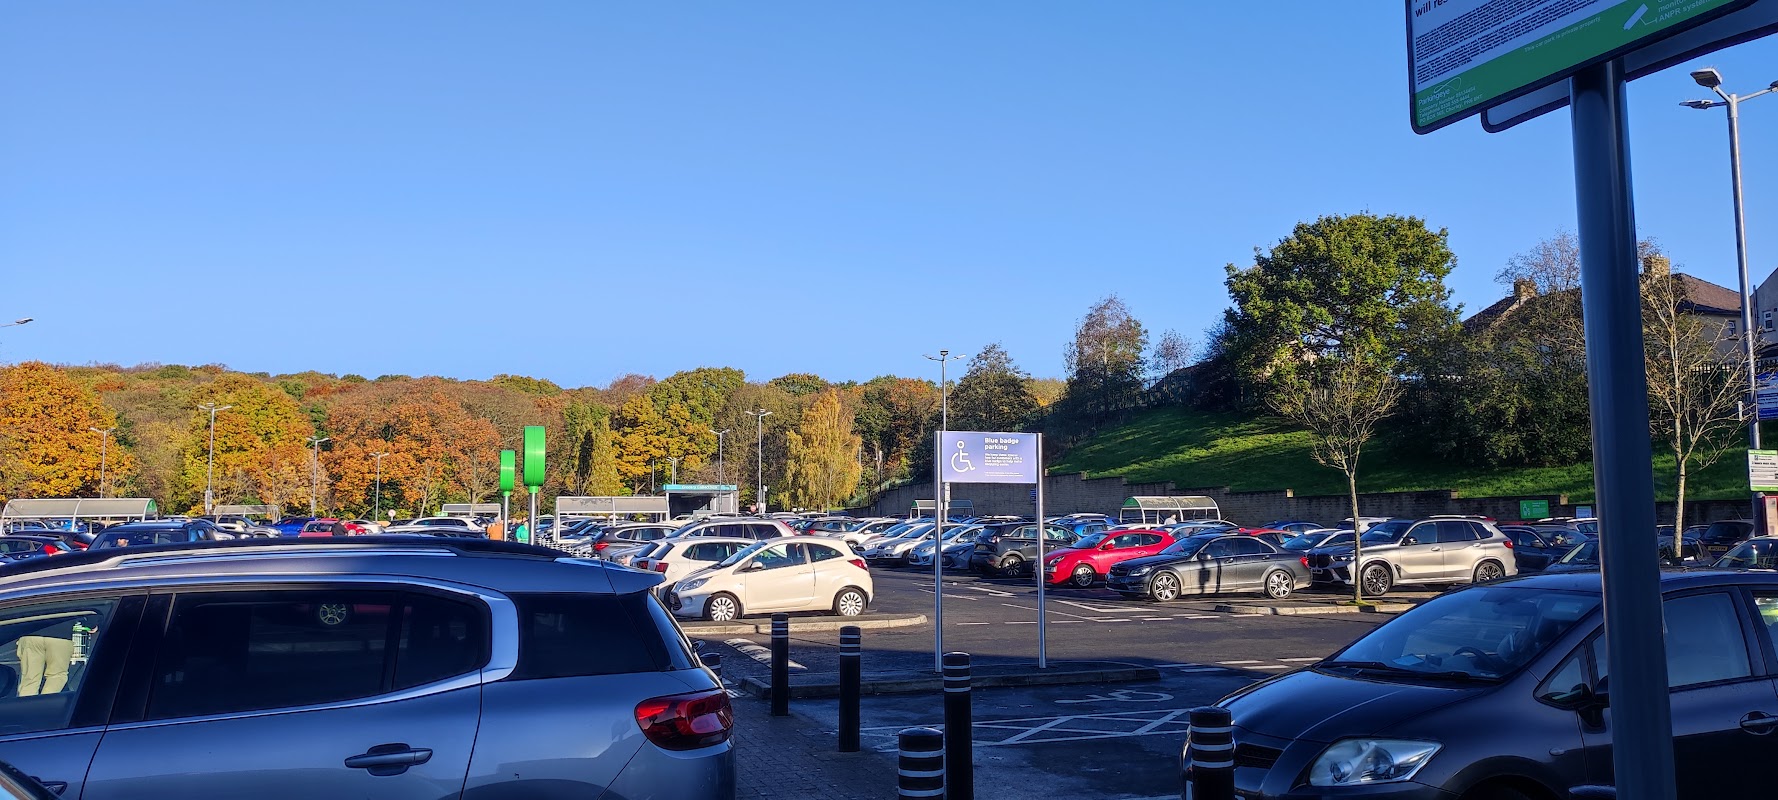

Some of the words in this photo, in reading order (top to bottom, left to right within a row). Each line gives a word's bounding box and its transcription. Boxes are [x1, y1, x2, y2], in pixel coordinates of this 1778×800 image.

[1415, 1, 1431, 17] will
[1658, 8, 1681, 21] ANPR
[1543, 36, 1555, 45] park
[1561, 26, 1578, 37] private
[1579, 16, 1601, 30] property
